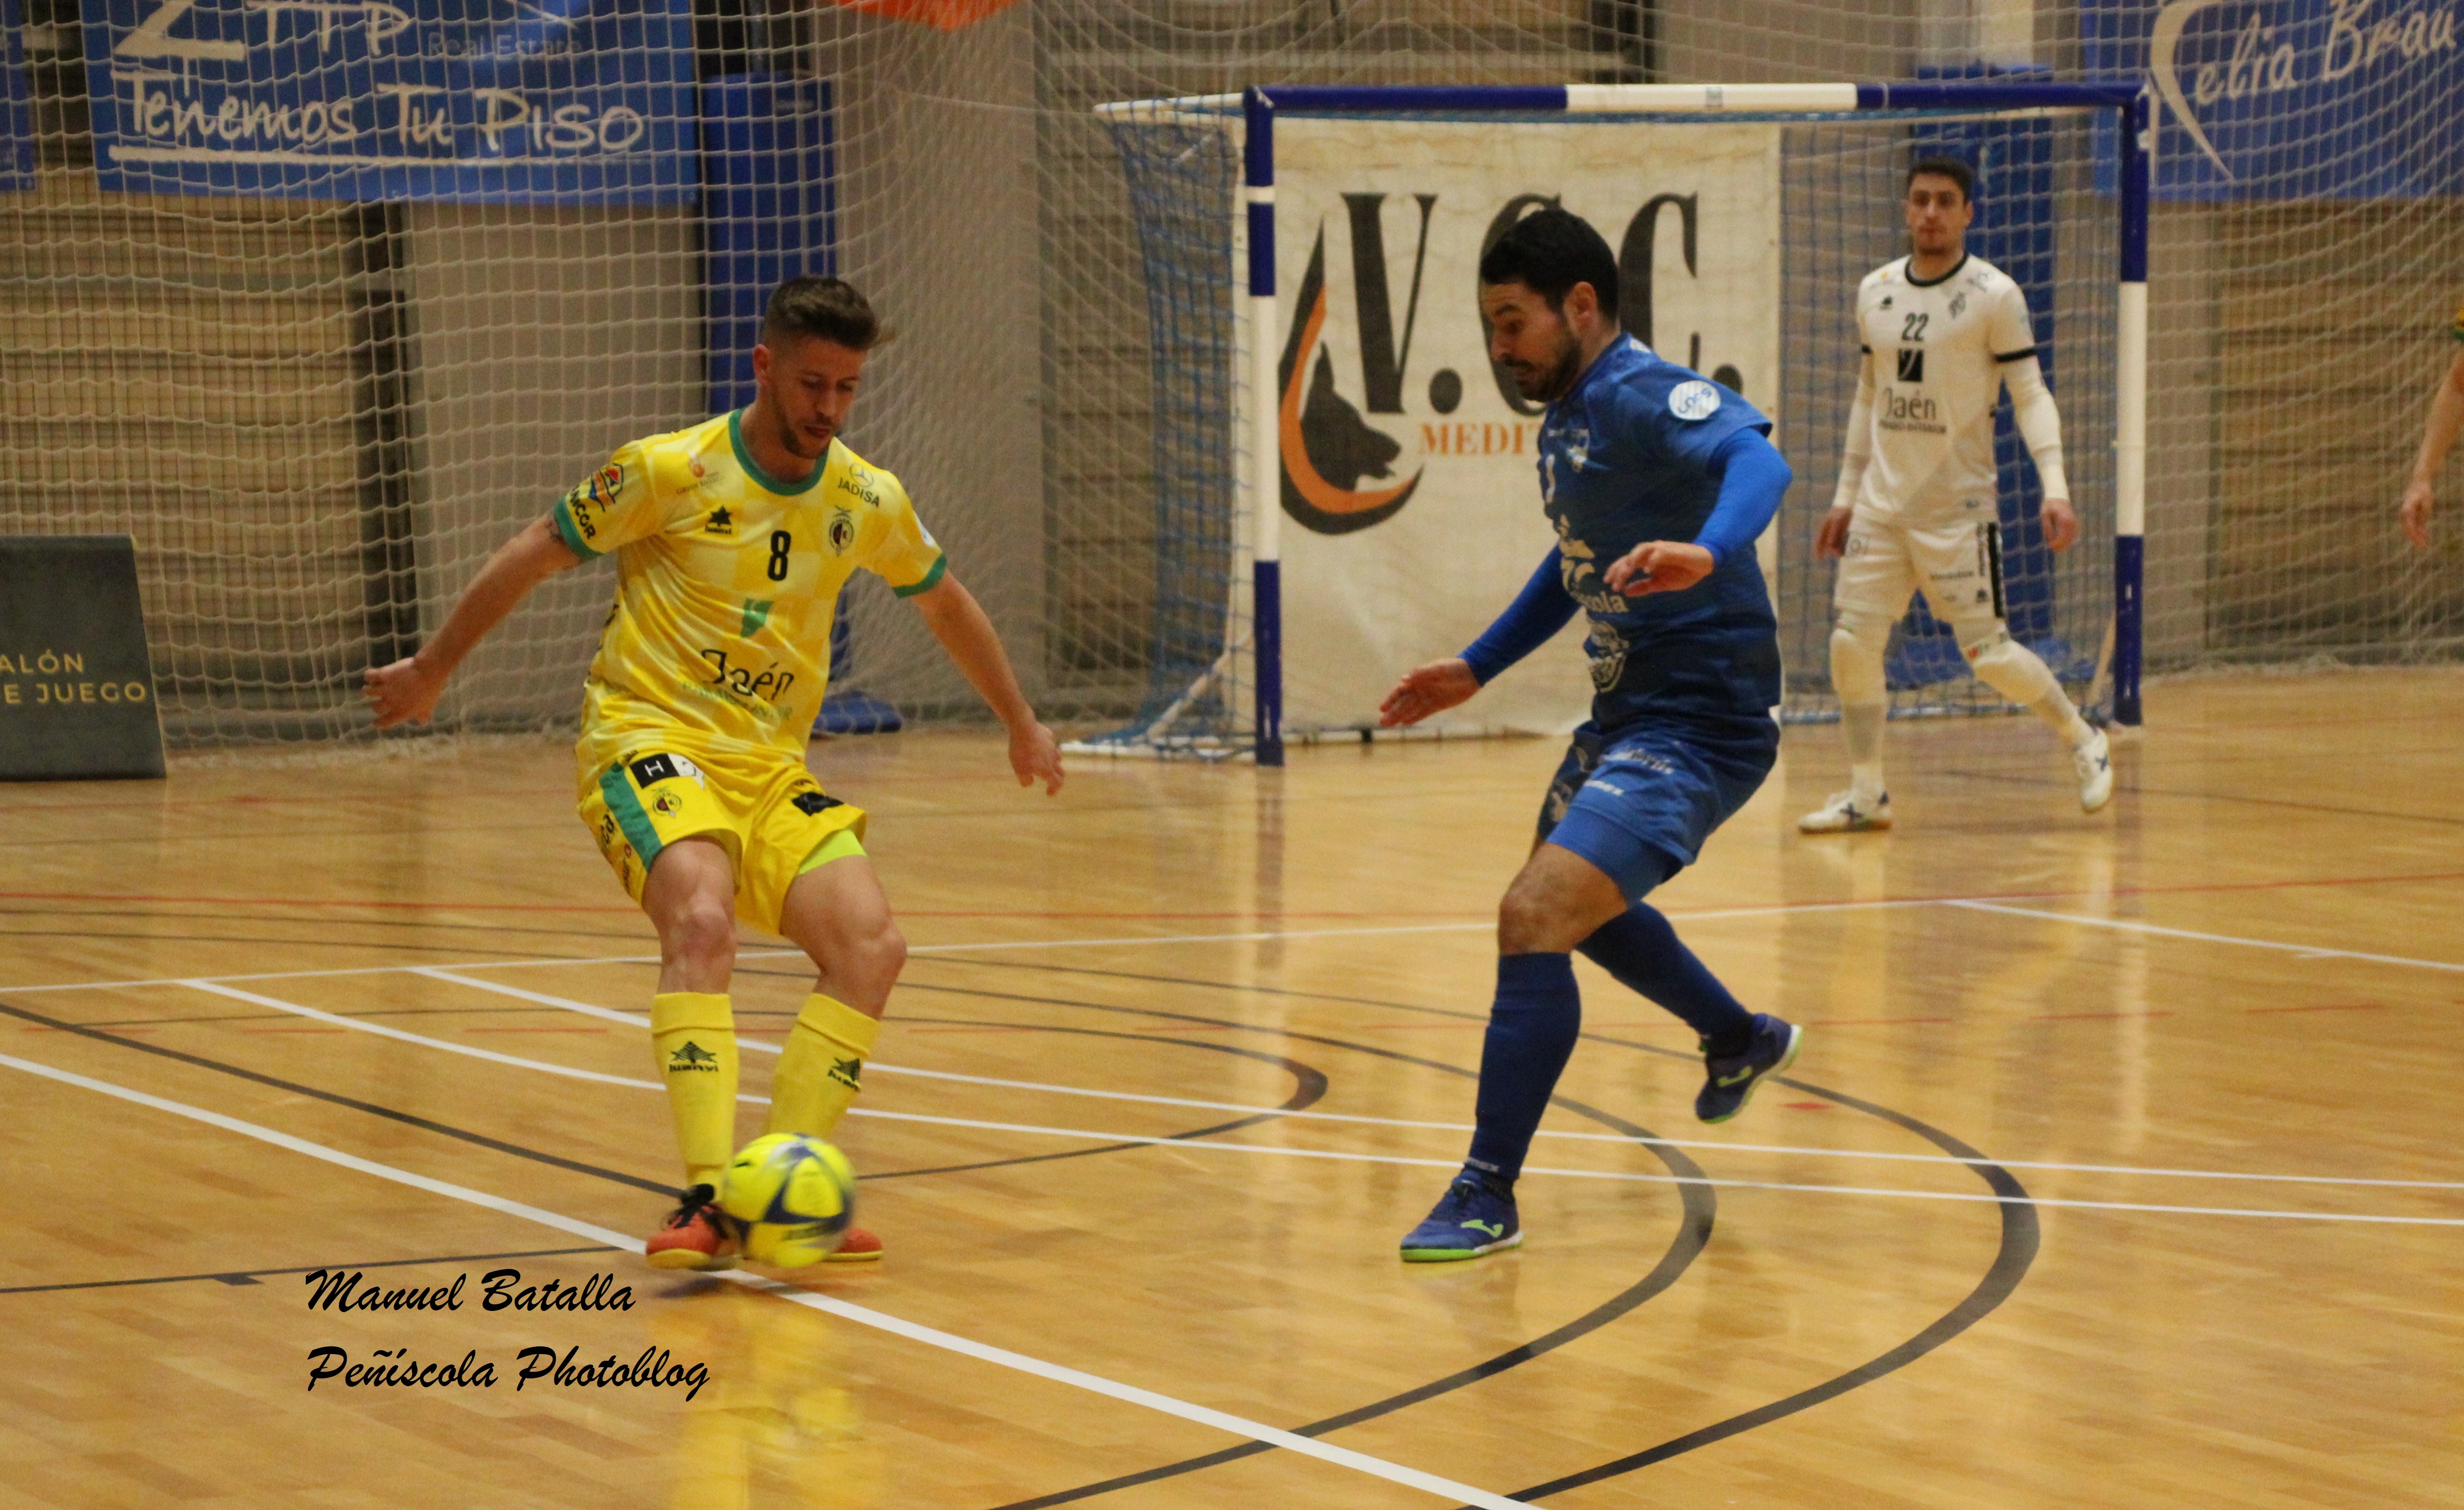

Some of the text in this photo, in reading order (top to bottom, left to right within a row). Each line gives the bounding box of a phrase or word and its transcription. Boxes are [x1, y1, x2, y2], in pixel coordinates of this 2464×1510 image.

[111, 70, 357, 143] Tenemos
[377, 82, 452, 145] Tu
[1902, 312, 1929, 342] 22
[1883, 386, 1936, 420] Jaén
[838, 477, 880, 507] JADISA
[767, 531, 791, 581] 8
[0, 649, 85, 673] ALÓN
[701, 649, 795, 701] Jaén
[3, 682, 147, 704] E JUEGO
